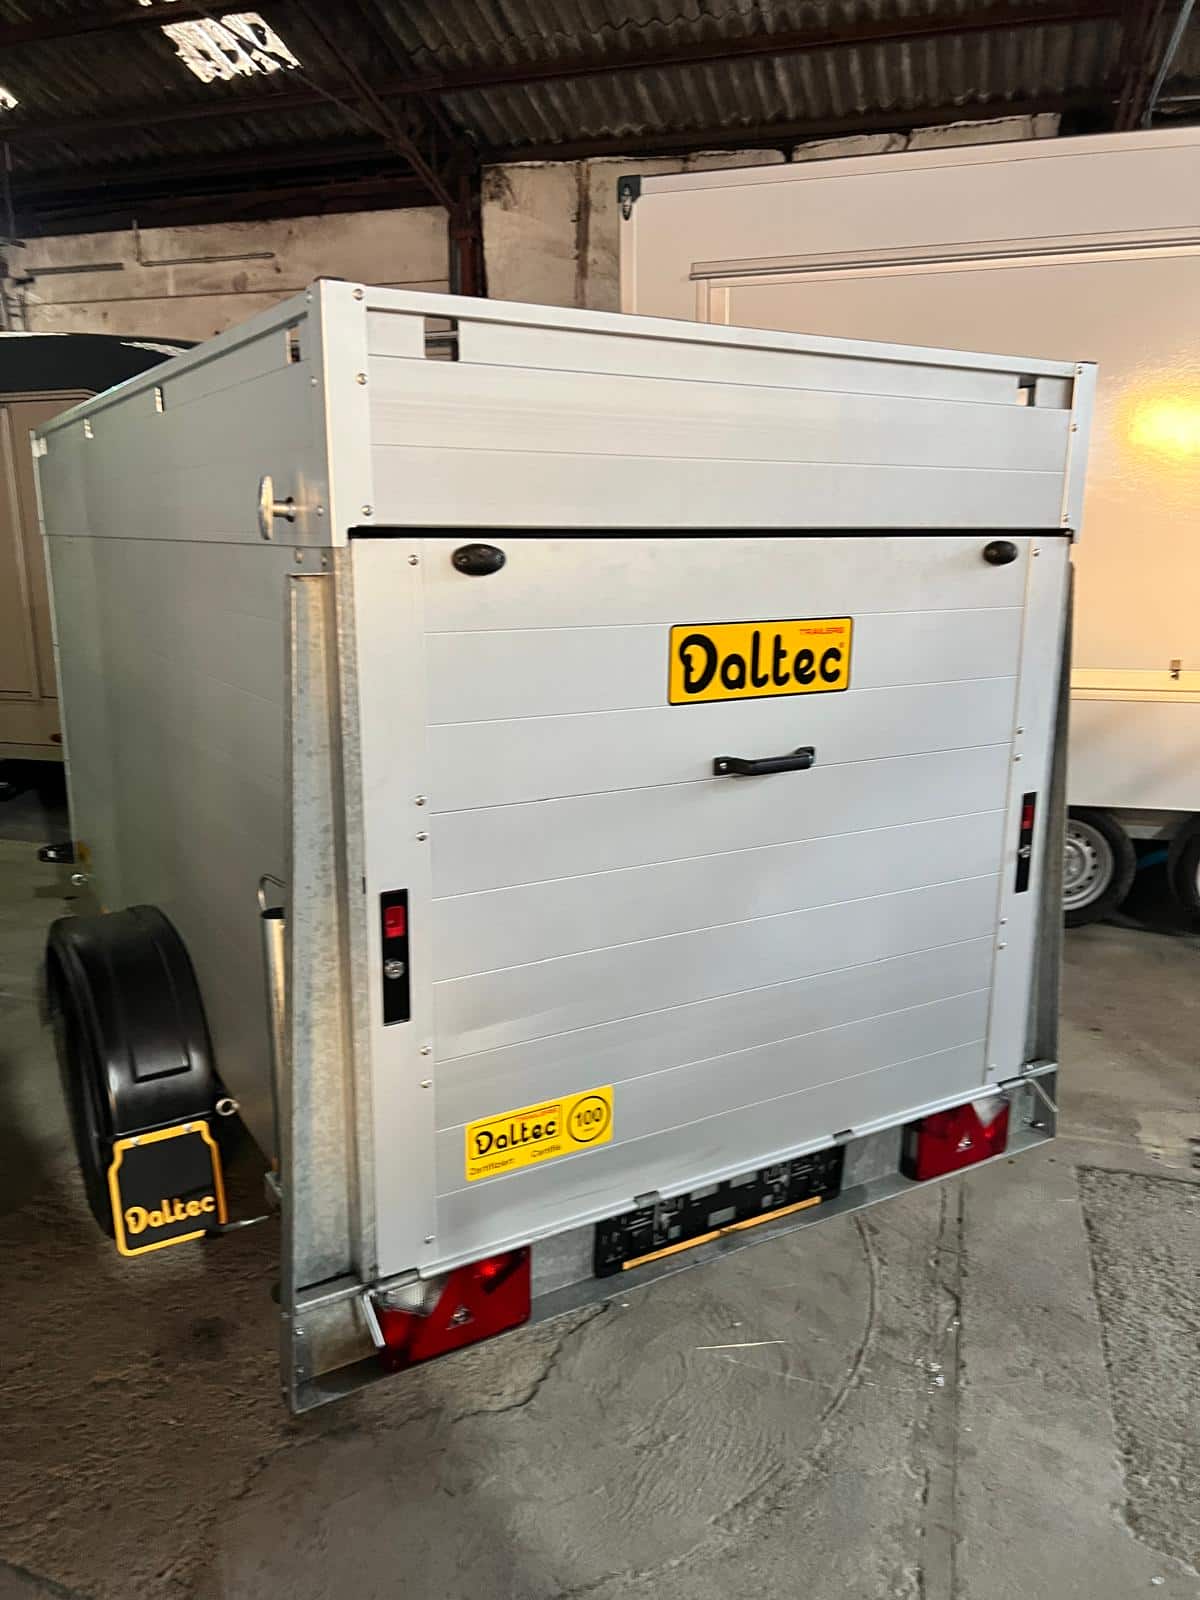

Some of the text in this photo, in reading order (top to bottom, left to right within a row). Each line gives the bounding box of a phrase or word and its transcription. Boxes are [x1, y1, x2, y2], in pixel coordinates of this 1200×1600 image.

[679, 630, 841, 694] Daltec
[575, 1107, 602, 1127] 100
[476, 1120, 556, 1155] Daltec
[124, 1196, 216, 1234] Daltec
